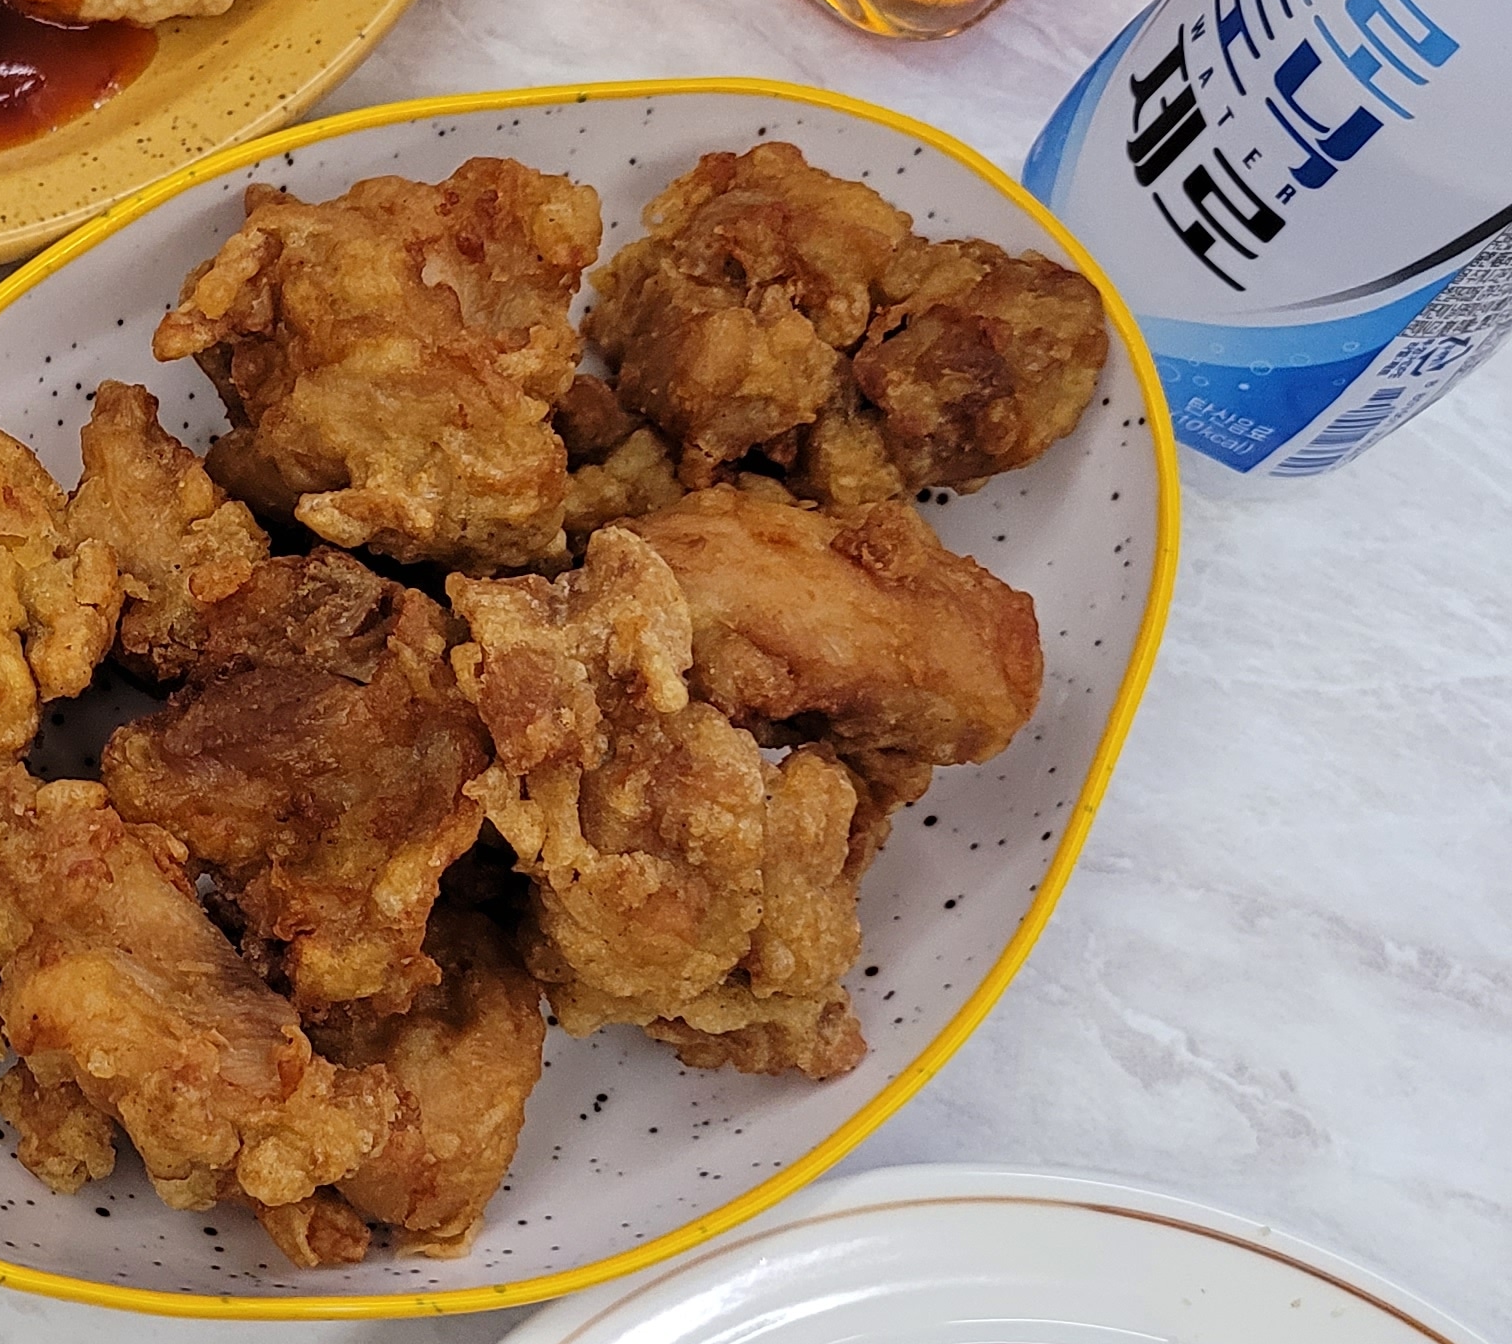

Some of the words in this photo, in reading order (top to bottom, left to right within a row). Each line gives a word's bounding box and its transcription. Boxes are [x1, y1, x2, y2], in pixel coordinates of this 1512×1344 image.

[1126, 23, 1286, 293] 제로
[1190, 13, 1297, 205] WATER
[1183, 396, 1276, 442] 탄산음료
